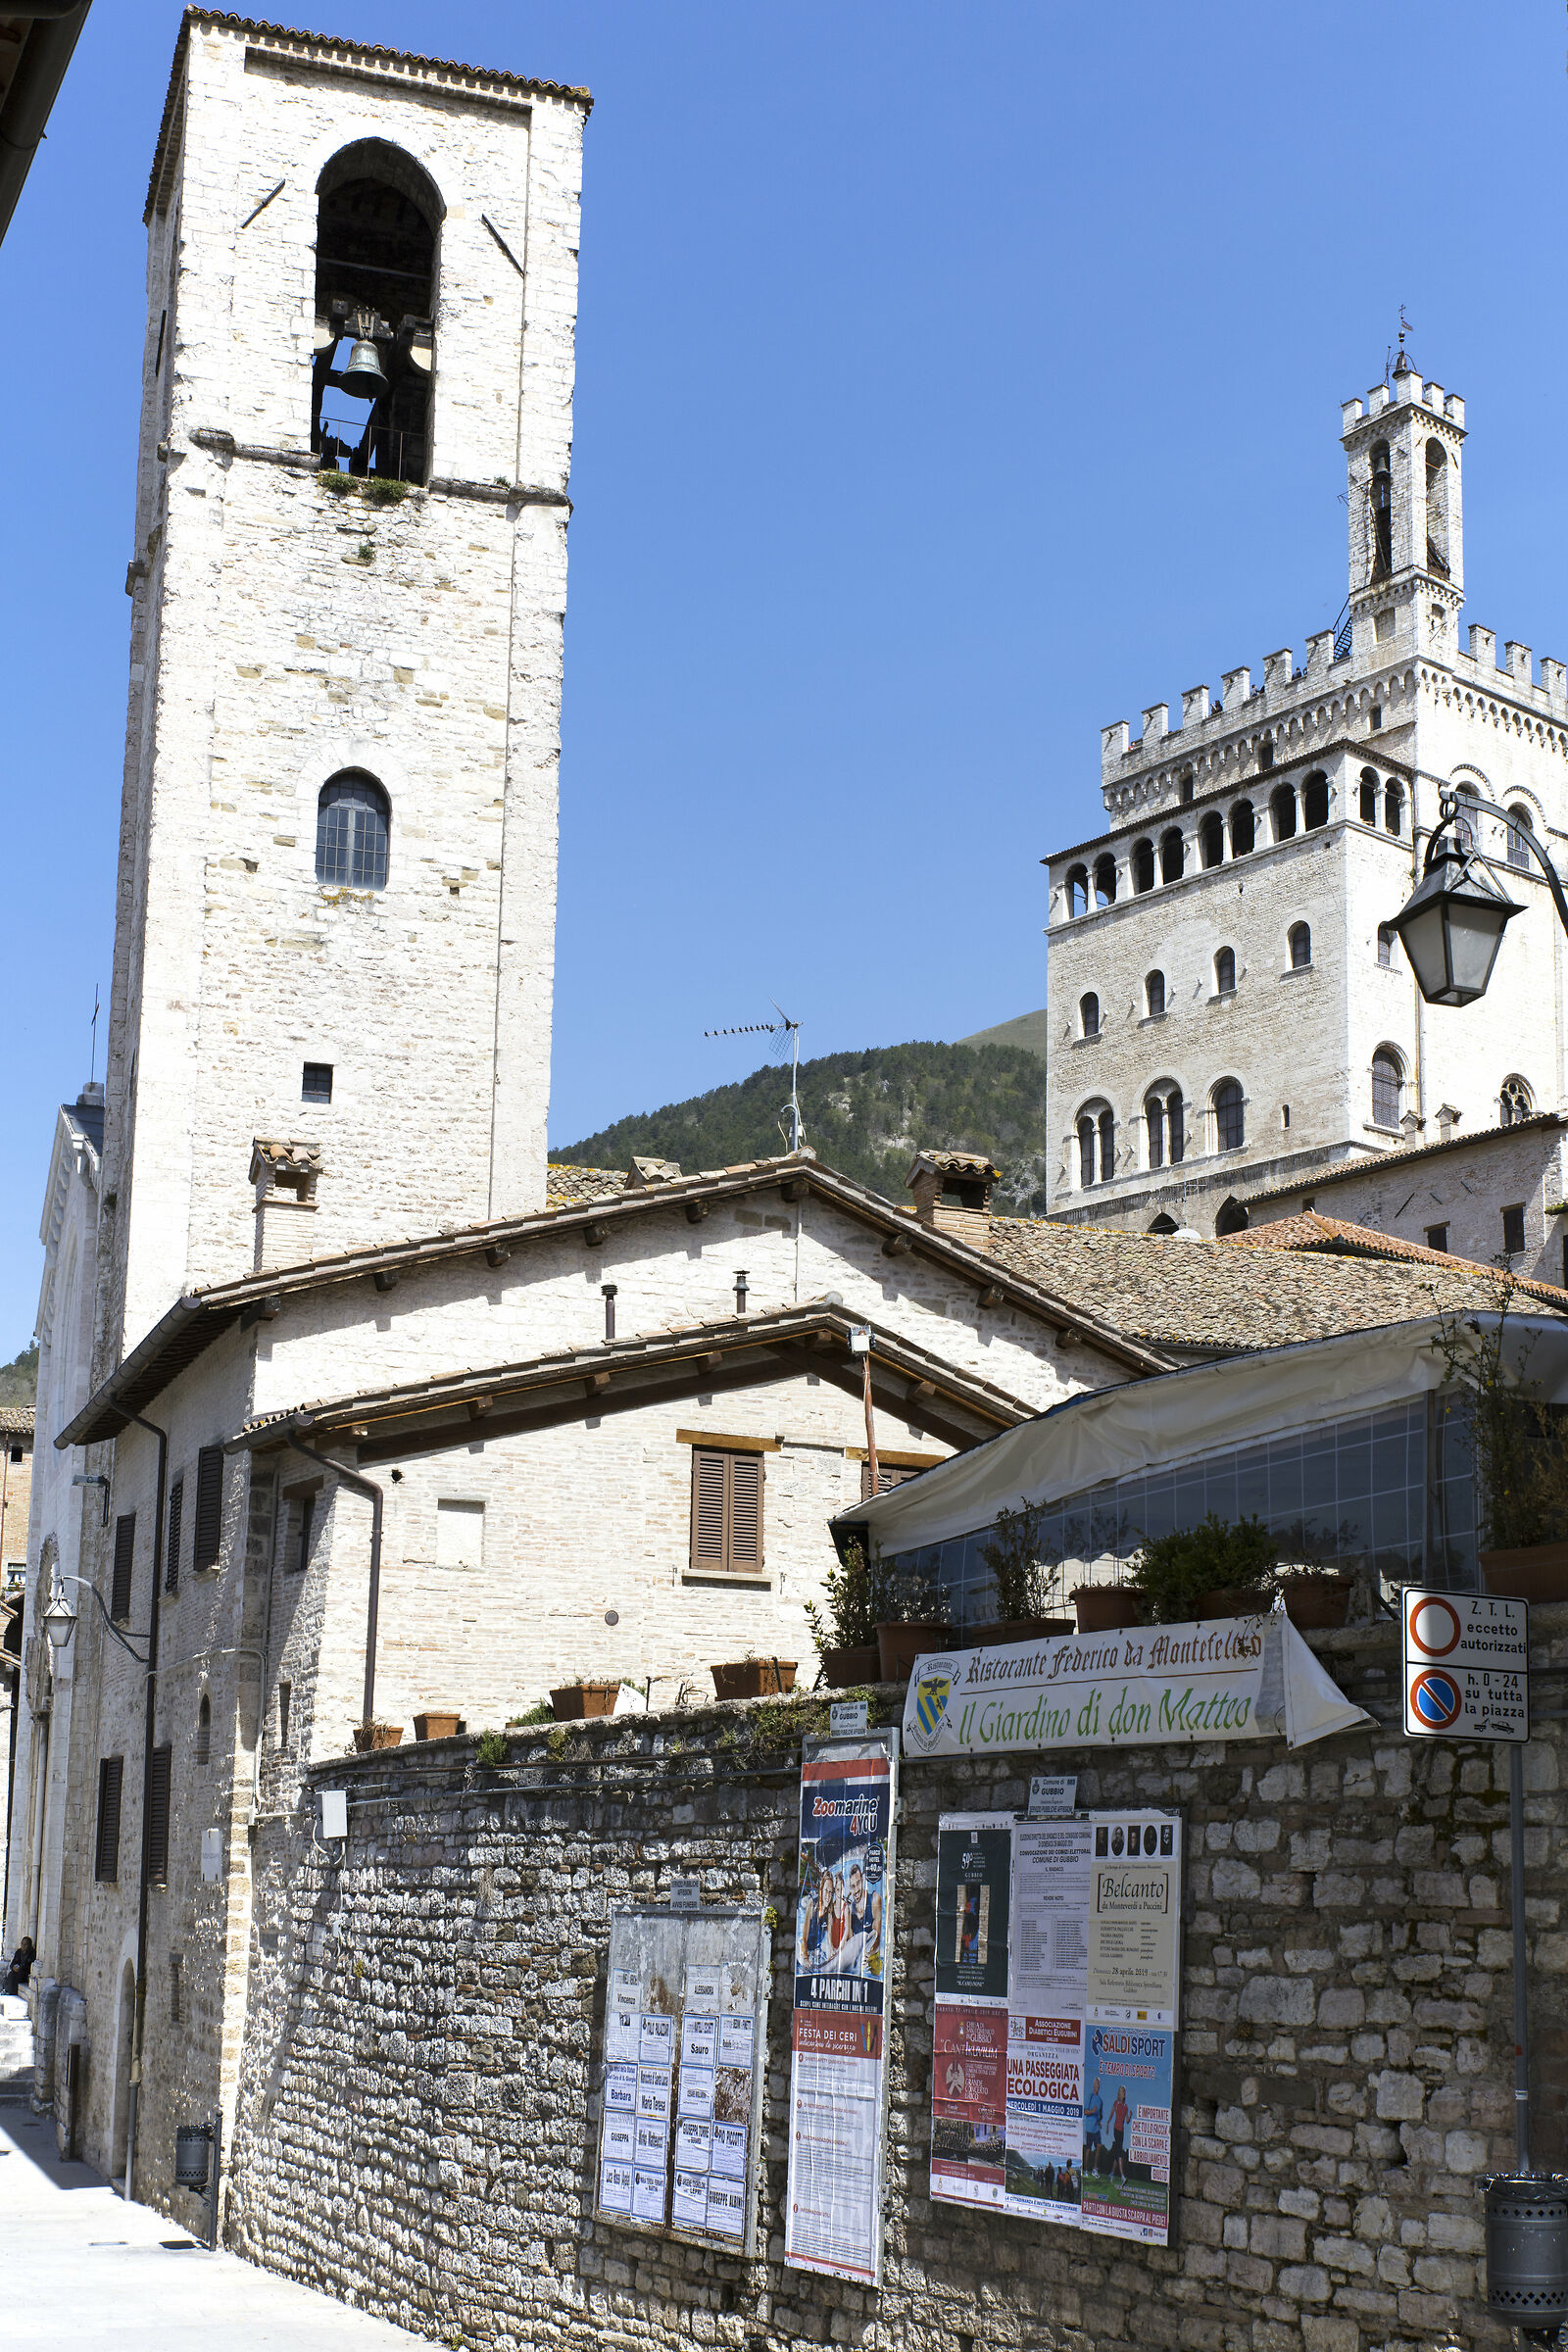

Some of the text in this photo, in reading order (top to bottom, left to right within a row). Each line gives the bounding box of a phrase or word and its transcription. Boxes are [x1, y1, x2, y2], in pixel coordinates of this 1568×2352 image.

[1467, 1623, 1518, 1637] eccetto
[1460, 1639, 1527, 1654] autorizzati
[965, 1650, 1048, 1685] Ristorante
[1046, 1641, 1120, 1680] Federico
[1124, 1640, 1144, 1667] da
[1467, 1673, 1479, 1686] h.
[1502, 1674, 1519, 1689] 24
[1464, 1689, 1523, 1702] su tutta
[839, 1712, 858, 1721] GUBBIO
[959, 1699, 977, 1745] Il
[979, 1692, 1070, 1743] Giardino
[1078, 1687, 1102, 1738] di
[1107, 1685, 1152, 1736] don
[1158, 1687, 1252, 1733] Matteo
[1464, 1702, 1525, 1718] la piazza
[812, 1793, 879, 1817] Zoomarine
[850, 1814, 878, 1837] 4YOU
[1102, 1873, 1164, 1898] Belcanto
[1102, 1900, 1108, 1910] da
[1108, 1901, 1138, 1910] Monteverdi
[1143, 1901, 1162, 1910] Puccini
[1119, 1967, 1134, 1978] aprile
[1135, 1968, 1149, 1977] 2019
[809, 1978, 868, 2003] 4 PARCHI IN 1
[1029, 2027, 1077, 2038] DIABETICI EUGUBINI
[1034, 2019, 1071, 2030] ASSOCIAZIONE
[799, 2028, 858, 2042] FESTA DEI CERI
[690, 2042, 710, 2055] Sauro
[1006, 2058, 1024, 2076] UNA
[1025, 2059, 1080, 2082] PASSEGGIATA
[1104, 2061, 1124, 2077] TEMPO
[1125, 2063, 1131, 2078] DI
[611, 2088, 632, 2102] Barbara
[1006, 2077, 1080, 2101] ECOLOGICA
[641, 2094, 666, 2112] Maria Teresa
[1042, 2104, 1065, 2115] MAGGIO
[1066, 2107, 1080, 2117] 2019
[1142, 2106, 1169, 2122] IMPORTANTE
[1131, 2120, 1141, 2132] CHE
[611, 2132, 629, 2143] GIUSEPPA
[1131, 2134, 1141, 2147] CON
[1141, 2136, 1148, 2148] LA
[1148, 2136, 1164, 2151] SCARPA
[1152, 2167, 1168, 2181] GIUSTO
[709, 2190, 728, 2207] GIUSEPPE
[1083, 2201, 1097, 2214] PARTI
[1096, 2203, 1105, 2215] CON
[1105, 2204, 1111, 2216] LA
[1112, 2205, 1128, 2220] GIUSTA
[1128, 2209, 1146, 2223] SCARPA
